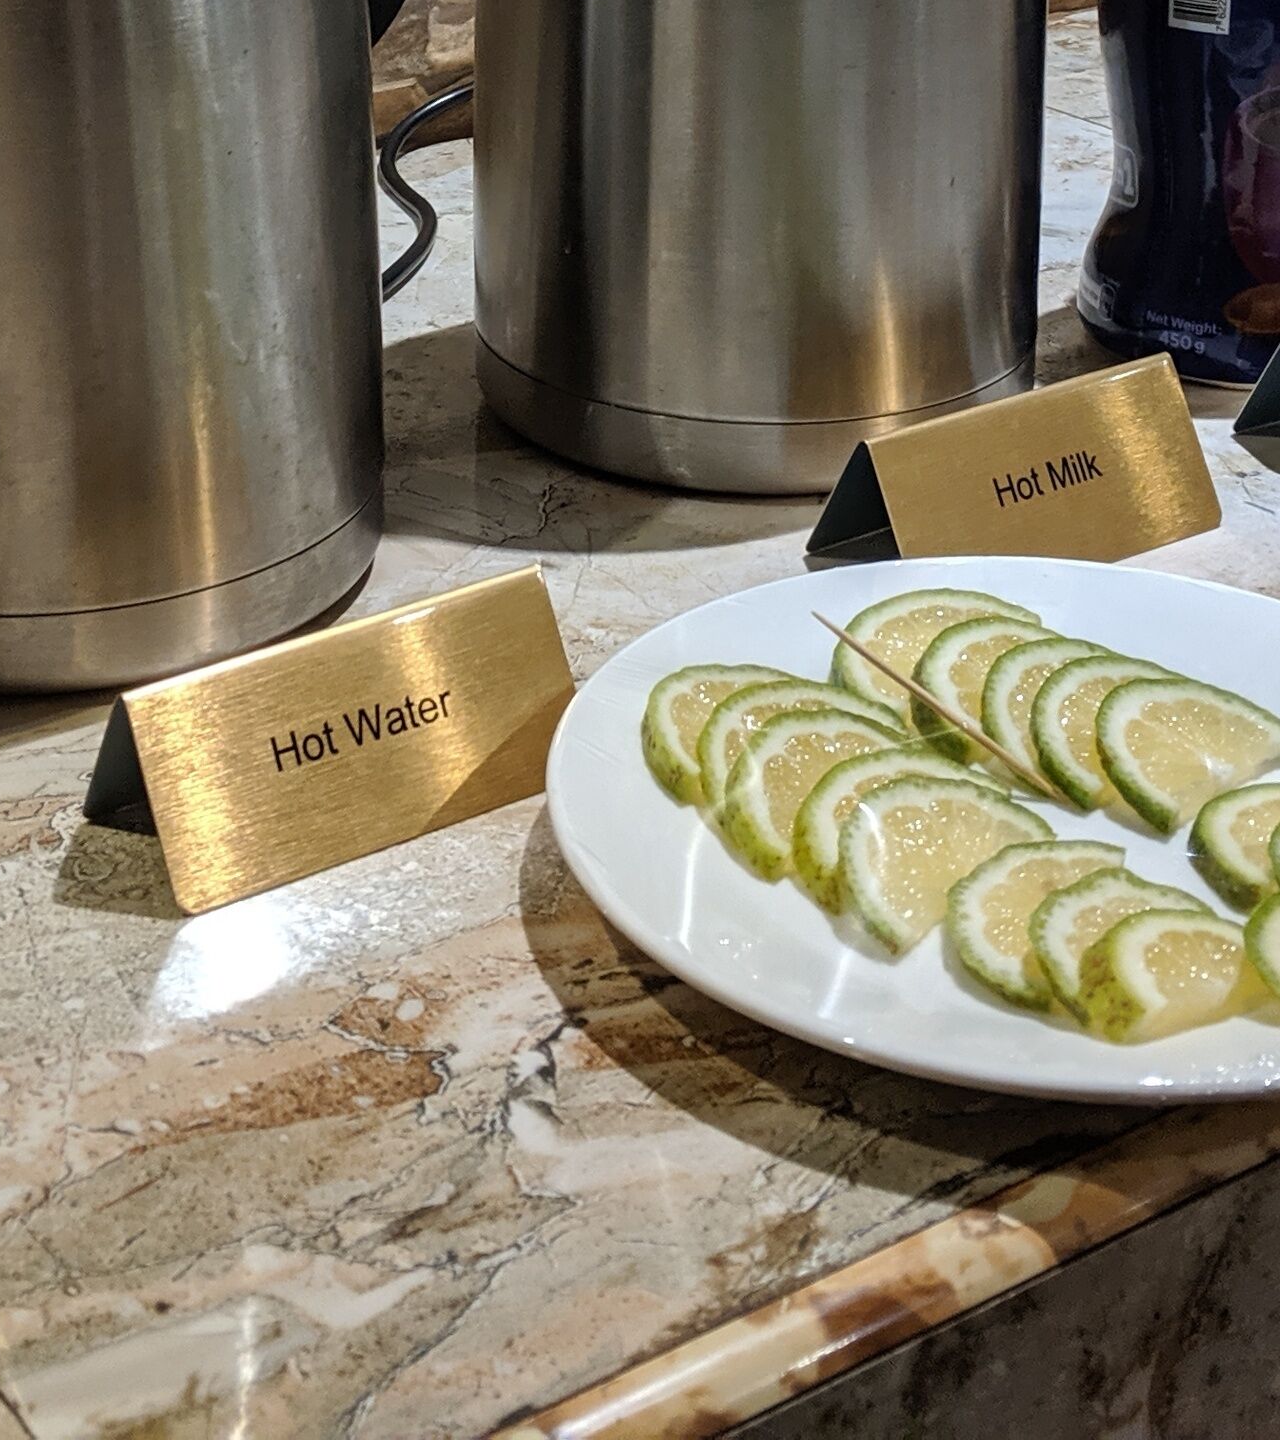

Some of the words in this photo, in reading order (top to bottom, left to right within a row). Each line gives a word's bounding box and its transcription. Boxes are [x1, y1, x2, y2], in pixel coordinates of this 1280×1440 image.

[1145, 310, 1168, 327] Net
[1170, 317, 1223, 336] Weight:
[992, 467, 1045, 508] Hot
[1045, 450, 1103, 491] Milk
[270, 720, 339, 772] Hot
[343, 690, 451, 746] Water
